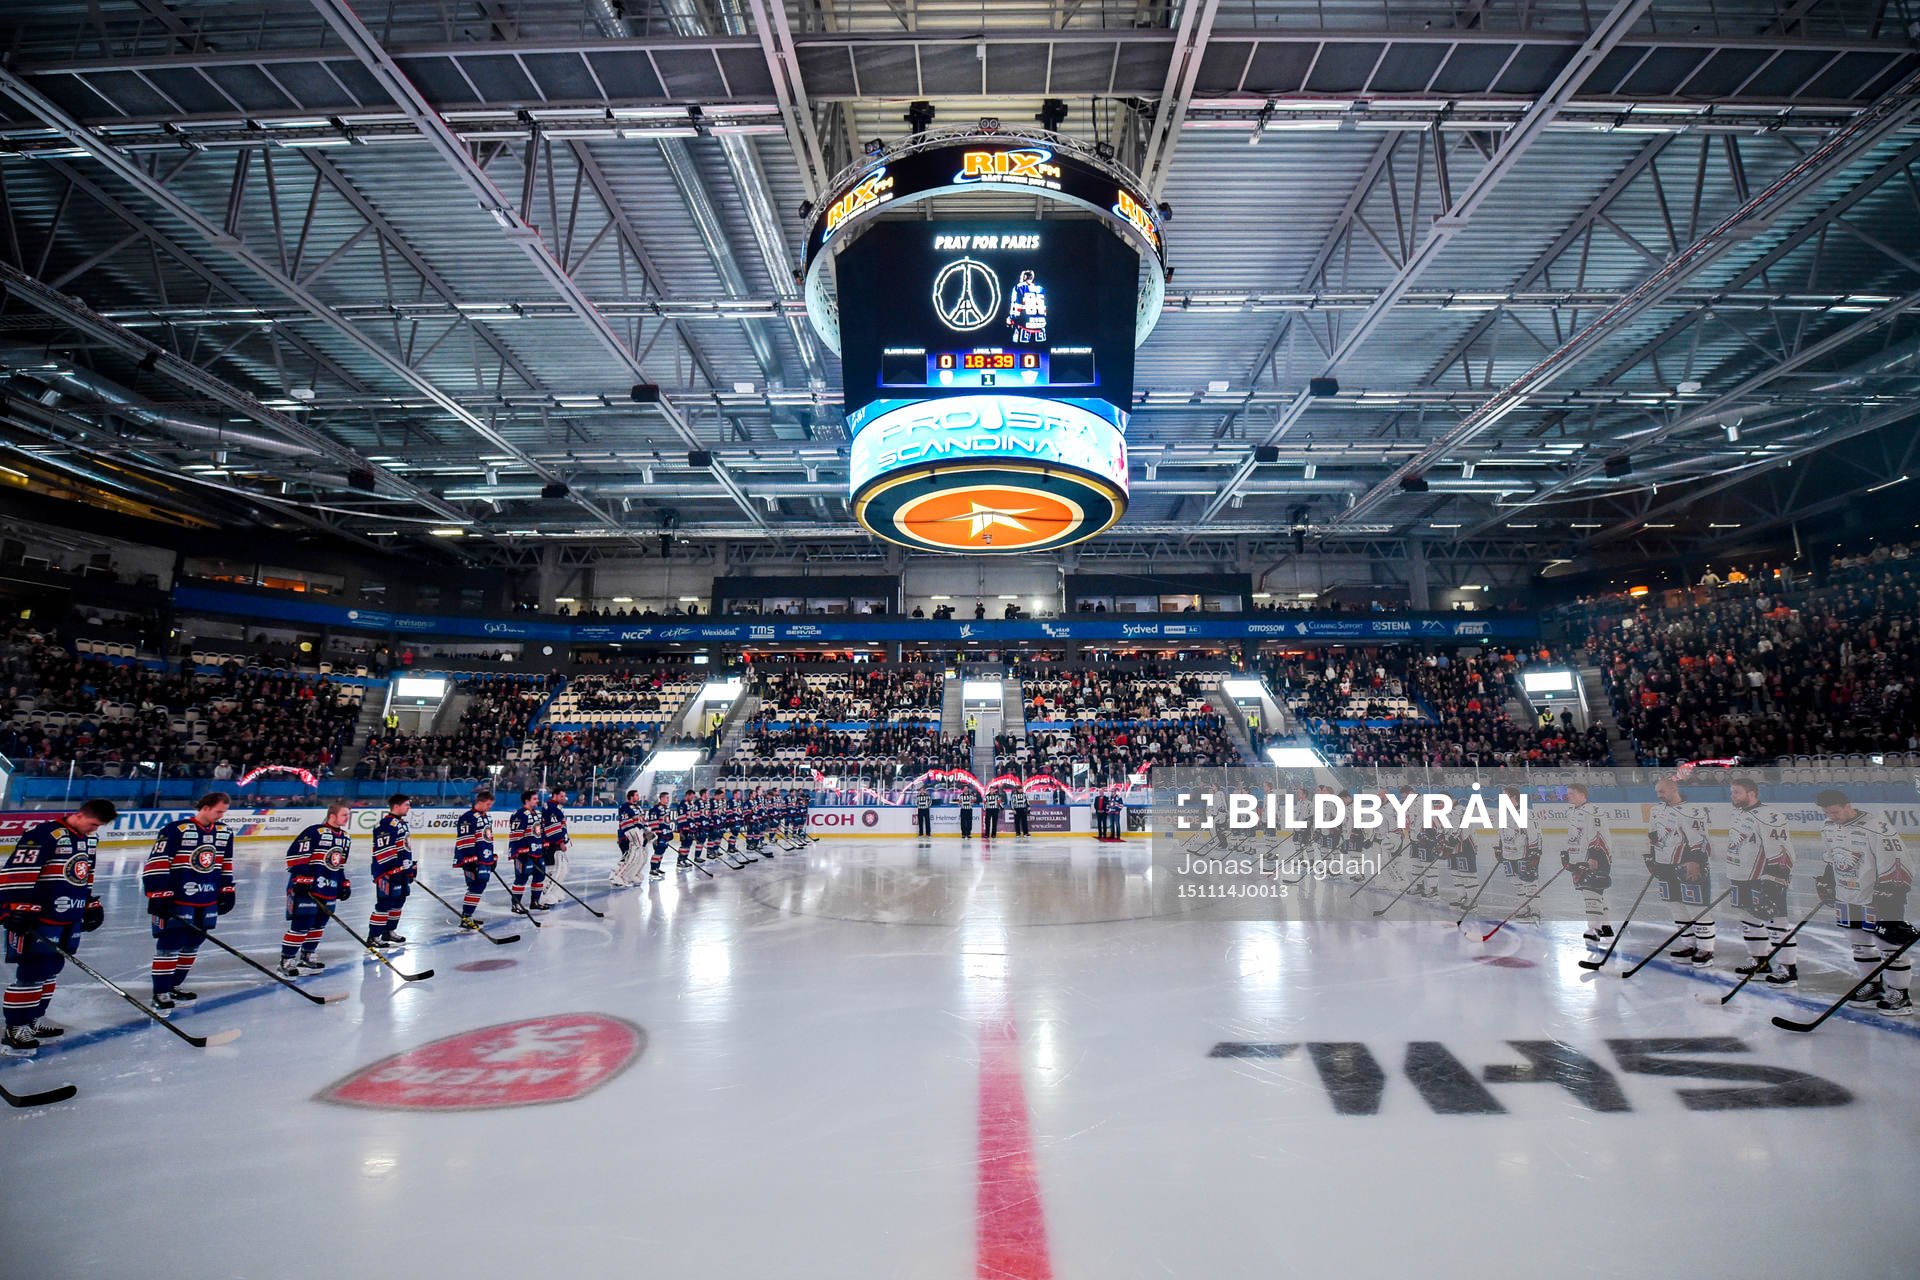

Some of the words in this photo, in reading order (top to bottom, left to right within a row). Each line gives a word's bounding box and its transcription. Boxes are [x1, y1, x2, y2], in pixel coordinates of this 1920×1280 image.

[964, 152, 1043, 179] RIX
[828, 178, 878, 231] RIX
[935, 235, 971, 250] PRAY
[972, 235, 999, 249] FOR
[1000, 235, 1041, 249] PARIS
[941, 355, 952, 368] 0
[964, 355, 1014, 369] 18:39
[1024, 354, 1036, 368] 0
[984, 374, 994, 385] 1
[879, 403, 979, 443] PRO
[749, 626, 775, 635] TMS
[1122, 623, 1158, 637] Sydved
[1248, 624, 1285, 632] OTTOSSON
[1381, 622, 1411, 631] STENA
[621, 632, 645, 640] NCC
[220, 816, 267, 825] ronobergs
[806, 814, 855, 826] ICOH
[376, 835, 390, 848] 87
[1769, 829, 1788, 841] 44
[298, 841, 310, 853] 19
[1882, 838, 1903, 852] 36
[12, 848, 41, 864] 53
